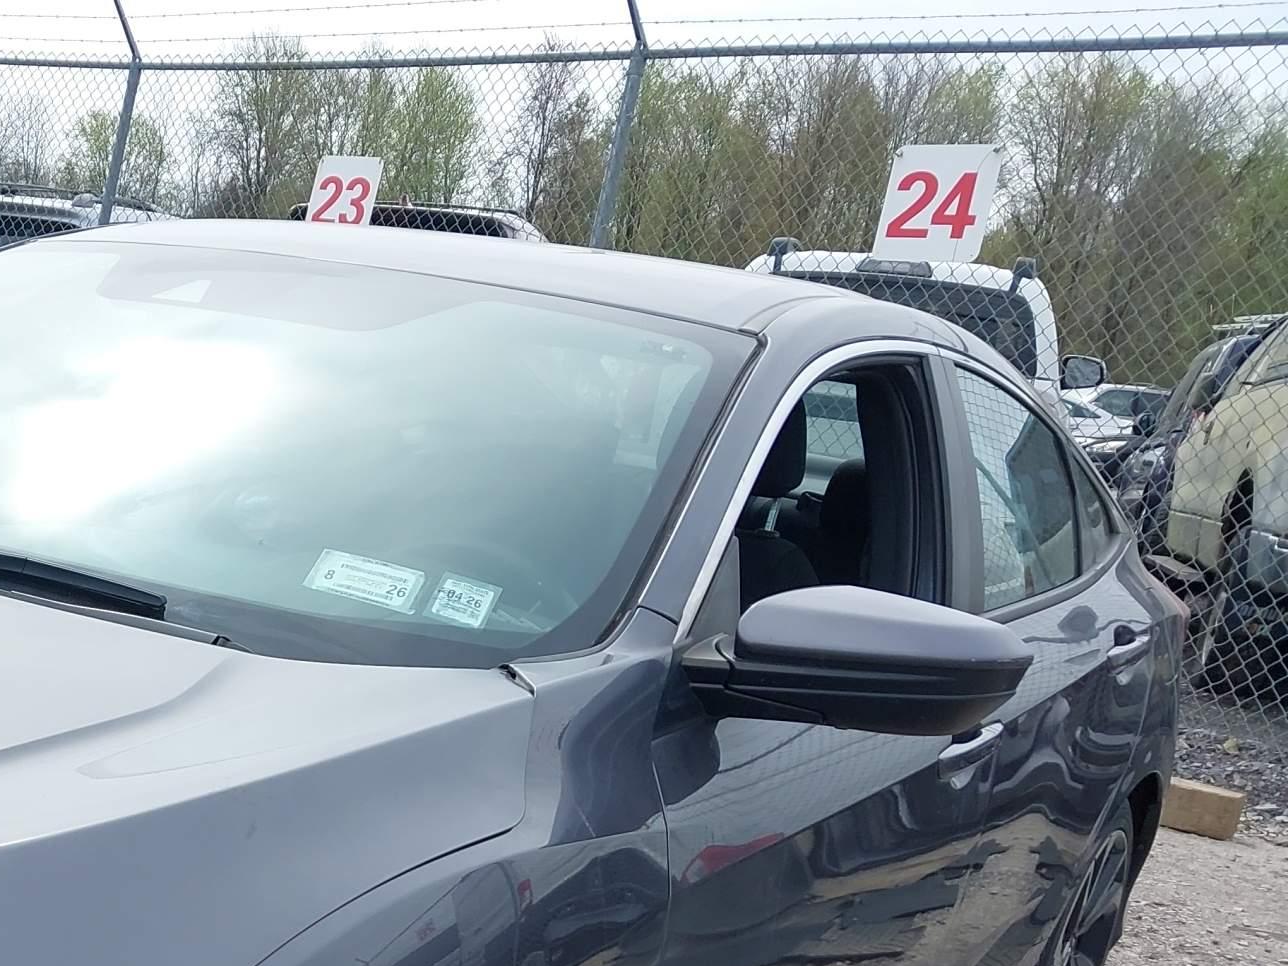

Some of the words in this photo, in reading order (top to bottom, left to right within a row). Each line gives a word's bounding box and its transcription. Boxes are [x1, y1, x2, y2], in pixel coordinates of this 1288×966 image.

[311, 175, 372, 225] 23
[885, 170, 978, 240] 24
[323, 568, 336, 581] 8
[385, 583, 408, 598] 26
